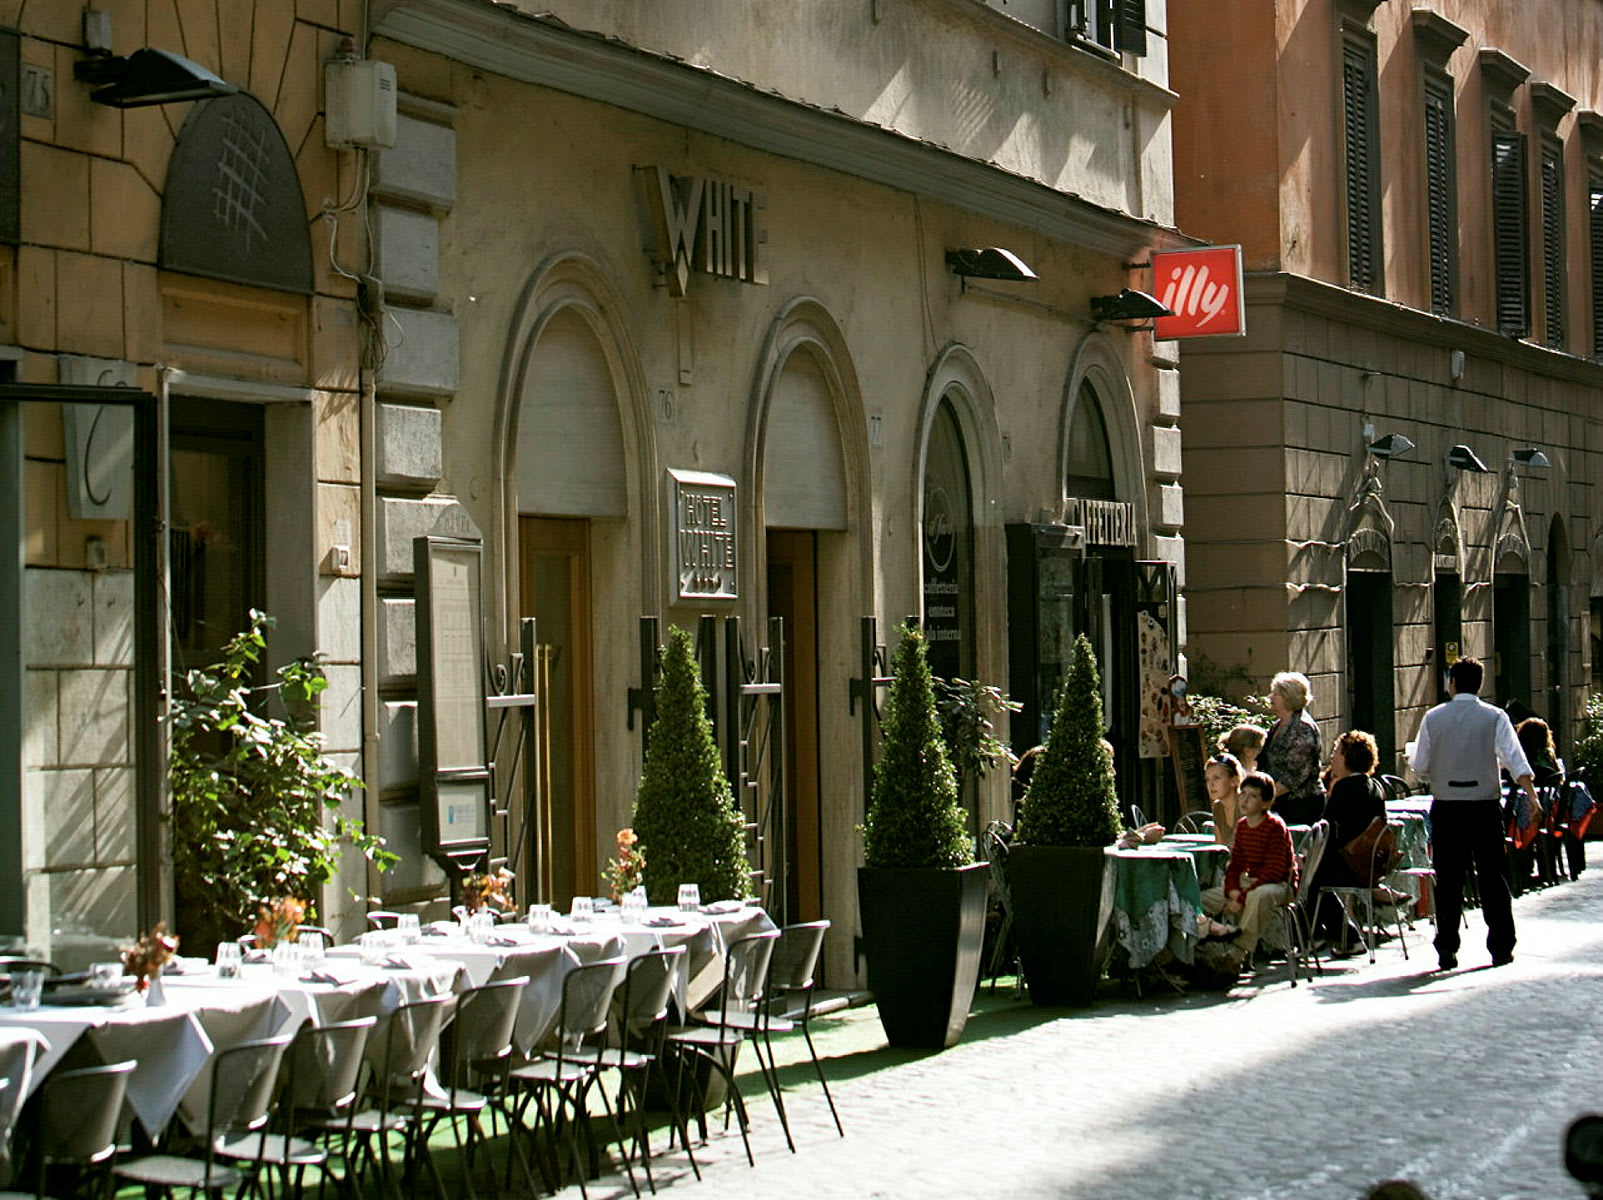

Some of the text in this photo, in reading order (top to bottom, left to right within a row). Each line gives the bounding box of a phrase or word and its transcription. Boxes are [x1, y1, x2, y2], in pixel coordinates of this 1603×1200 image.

[26, 69, 50, 112] 75
[657, 163, 769, 296] WHITE
[1161, 264, 1229, 327] illy
[658, 389, 673, 420] 76
[685, 493, 728, 527] HOTEL
[680, 529, 734, 568] WHITE
